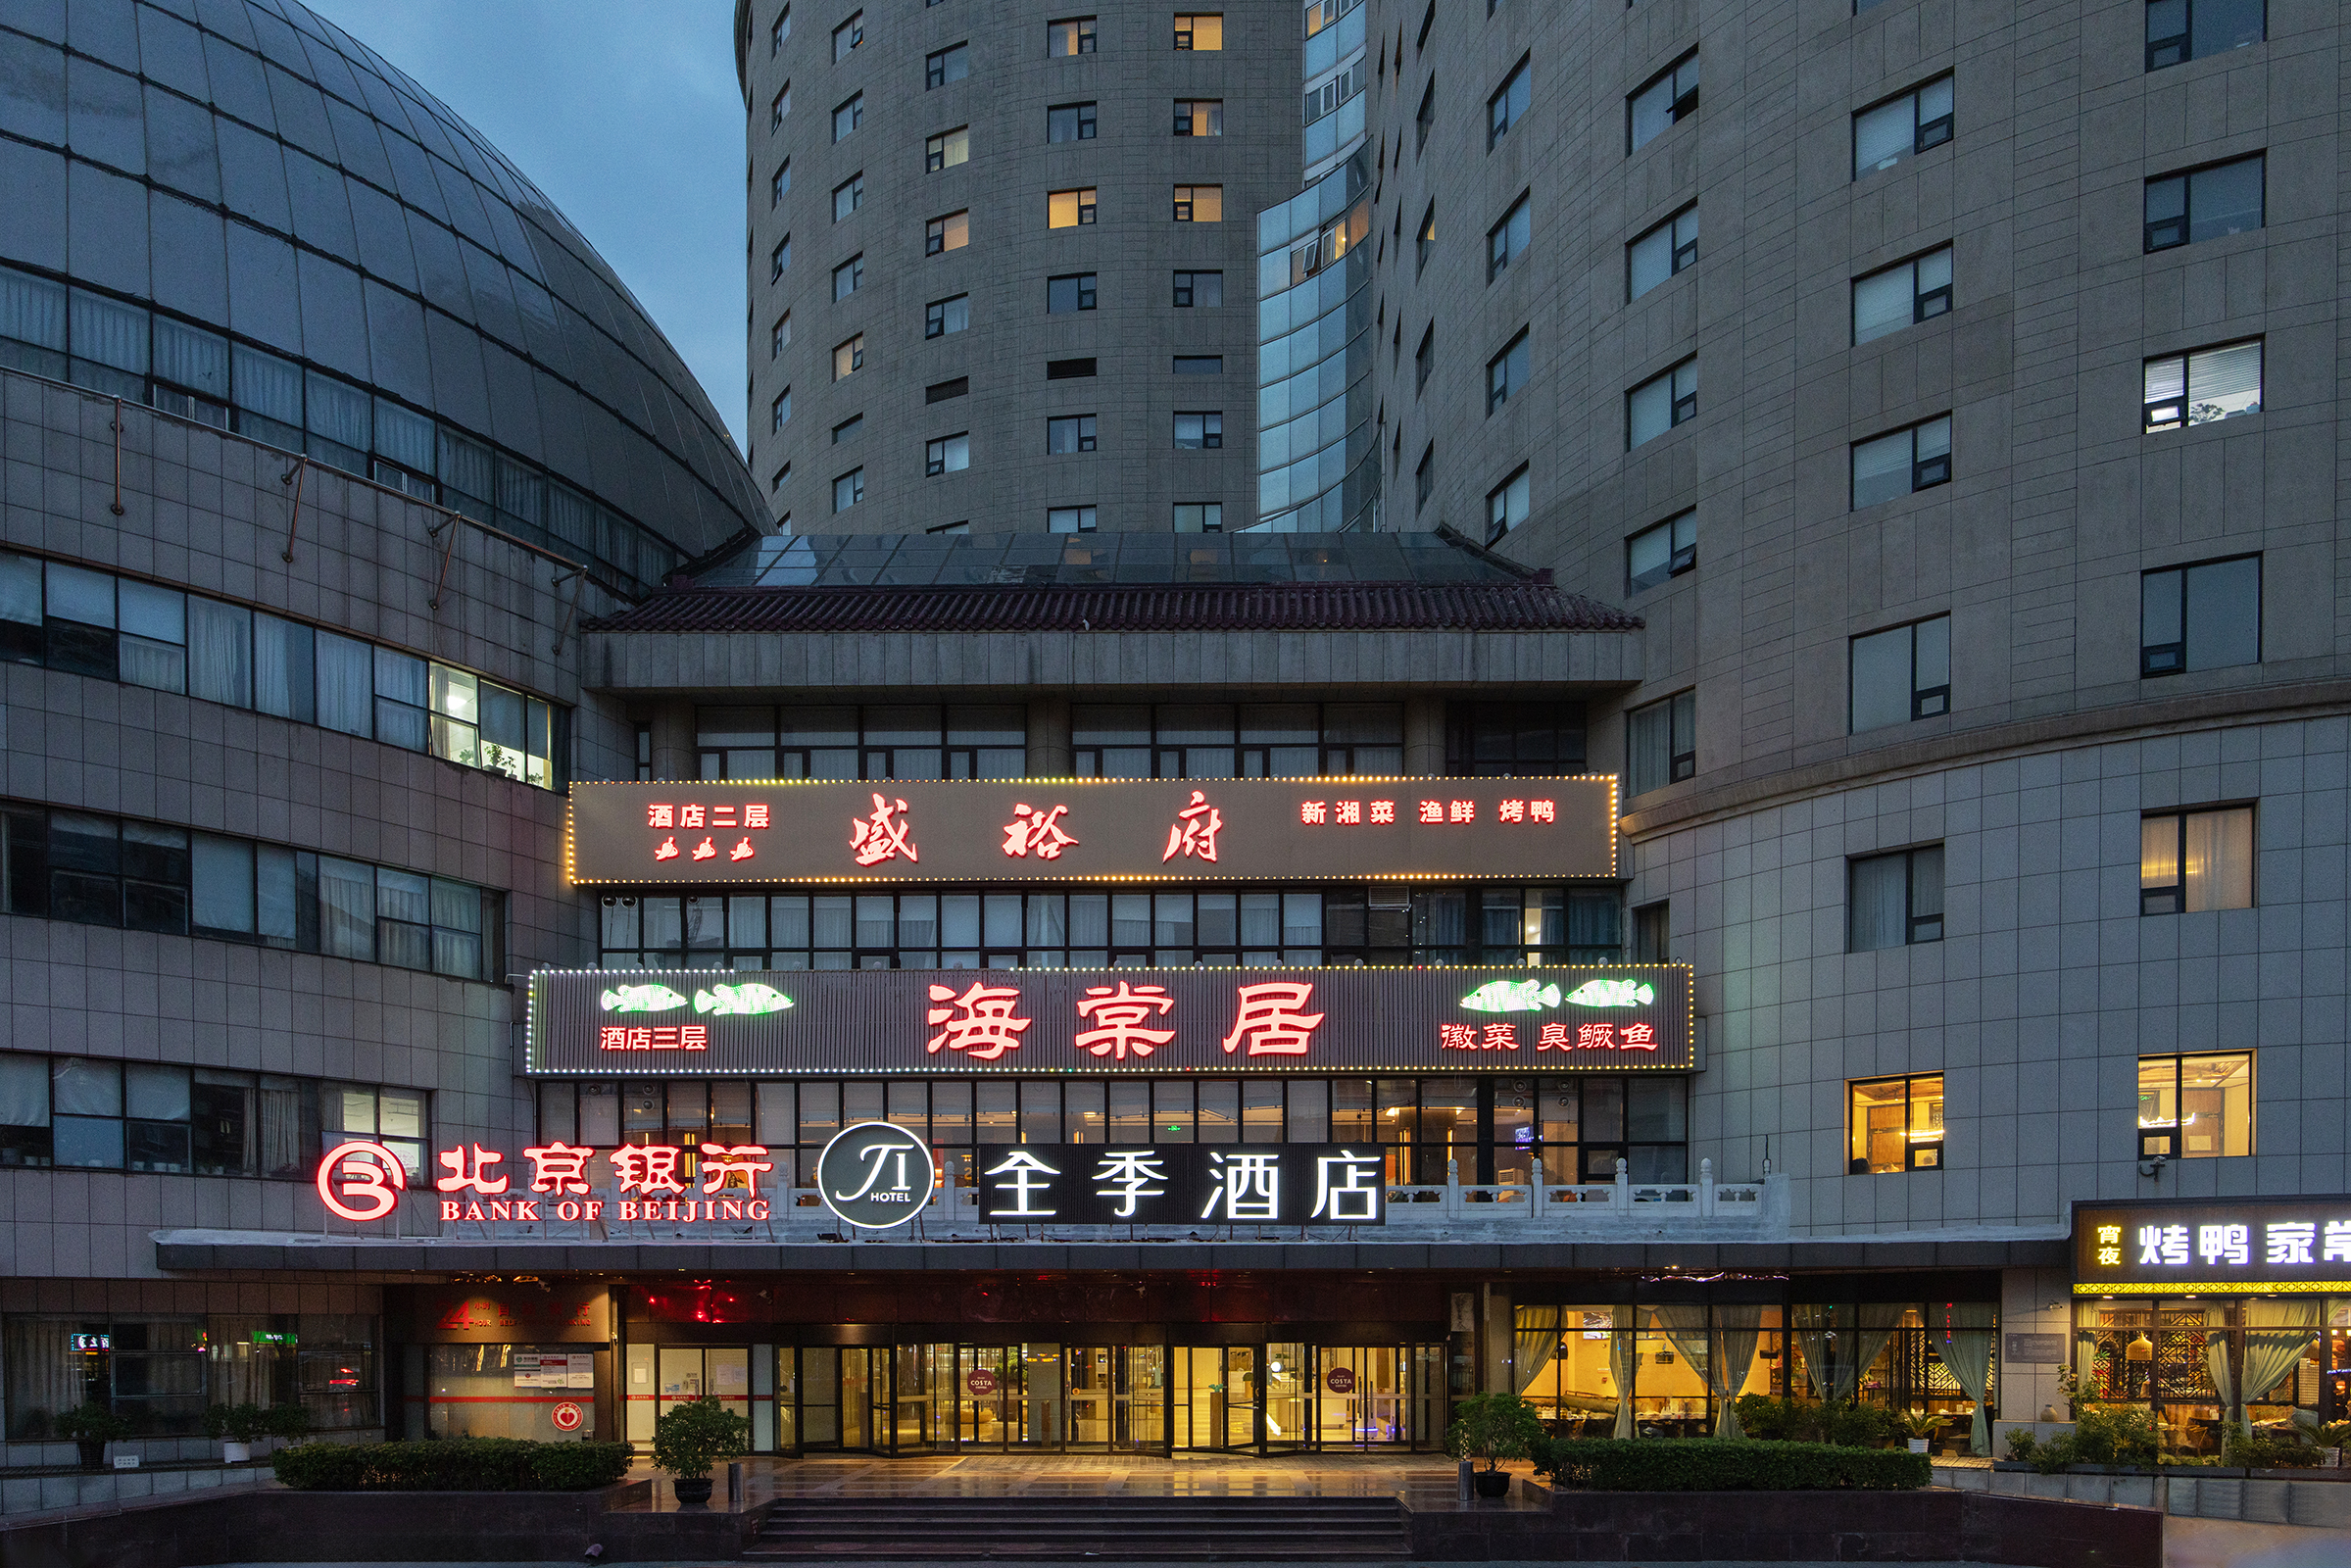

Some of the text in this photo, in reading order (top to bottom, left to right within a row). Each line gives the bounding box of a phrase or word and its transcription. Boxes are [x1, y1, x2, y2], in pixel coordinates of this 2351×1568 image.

[647, 803, 770, 829] 酒店二层
[1300, 799, 1556, 825] 新湘菜 渔鲜 烤鸭
[848, 790, 1223, 867] 盛裕府
[926, 980, 1325, 1060] 海棠居
[599, 1024, 708, 1052] 酒店三层
[1440, 1022, 1659, 1052] 徽菜 臭鳜鱼
[436, 1140, 773, 1198] 北京银行
[870, 1192, 911, 1202] HOTEL
[984, 1150, 1381, 1220] 全季酒店
[440, 1200, 771, 1222] BANK OF BEIJING
[2097, 1224, 2122, 1266] 宵夜
[436, 1299, 474, 1330] 24
